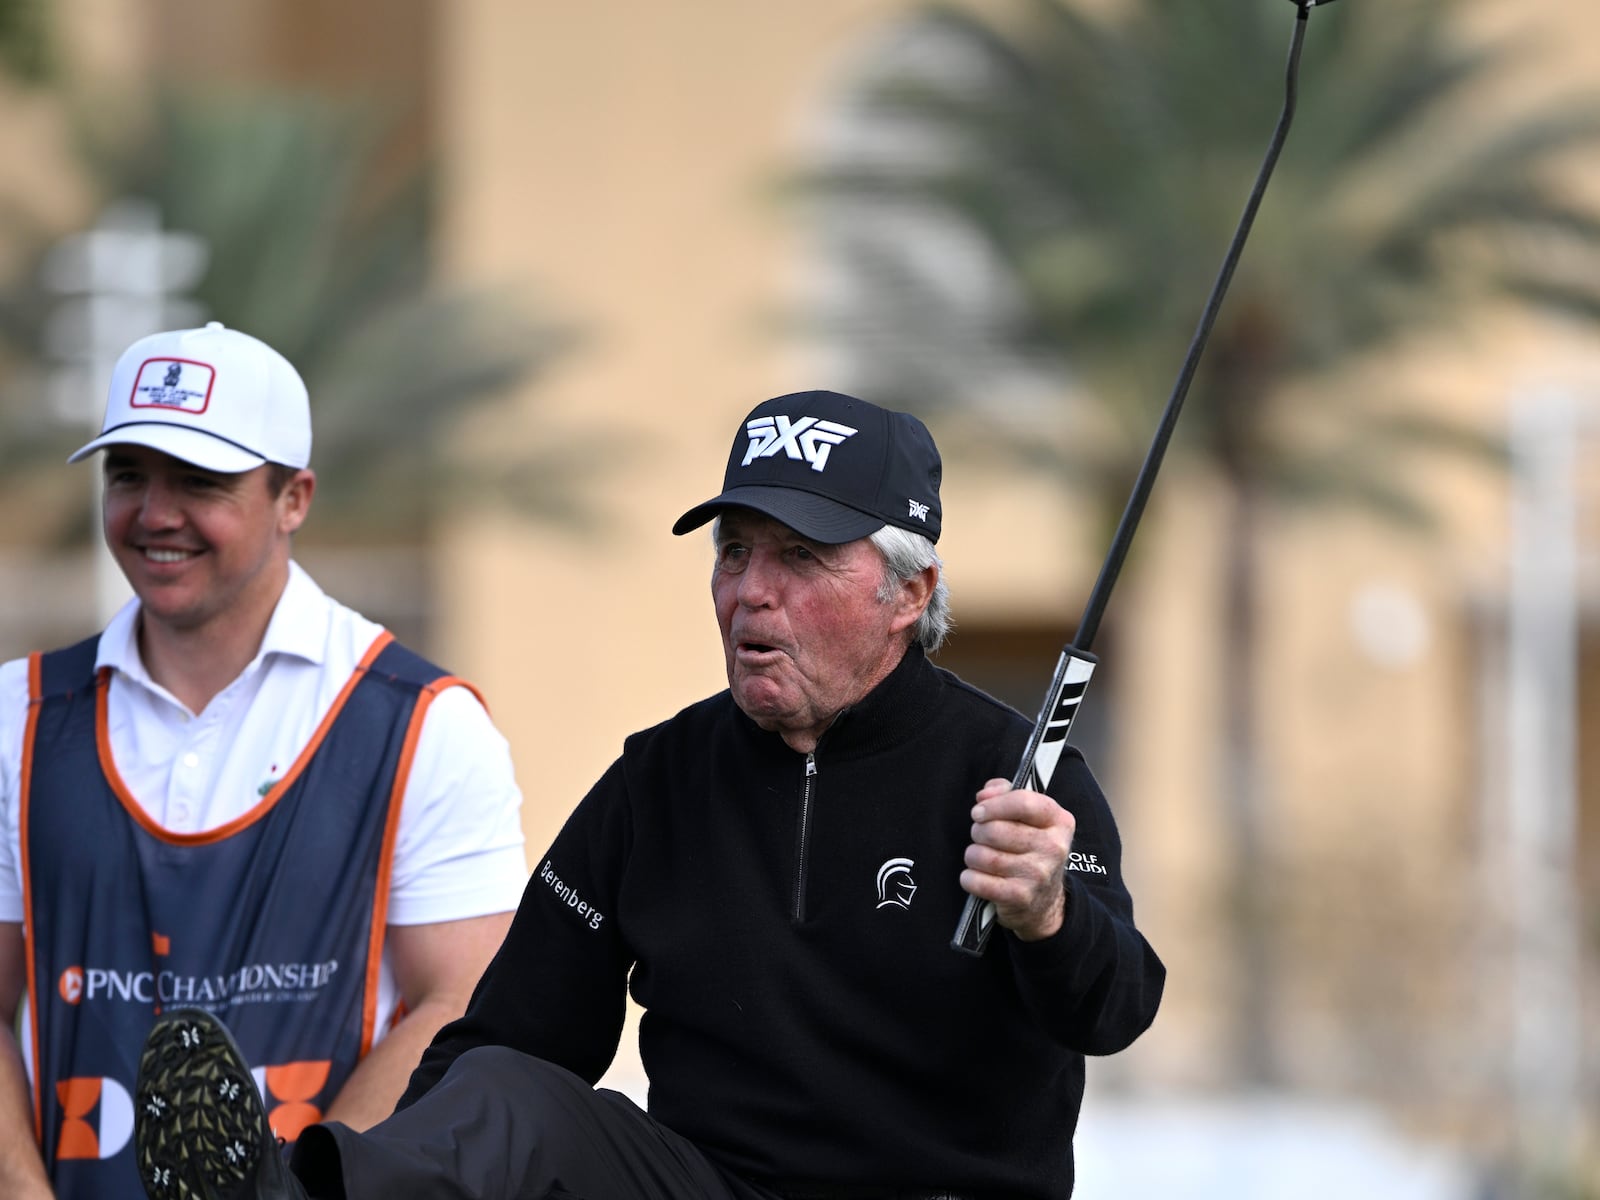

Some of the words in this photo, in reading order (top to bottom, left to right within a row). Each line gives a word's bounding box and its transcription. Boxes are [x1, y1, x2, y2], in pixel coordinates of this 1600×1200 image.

[741, 415, 859, 472] PXG
[908, 498, 930, 522] PXG
[1064, 862, 1107, 875] AUDI
[1068, 852, 1098, 864] OLF
[541, 860, 603, 930] Berenberg
[86, 969, 153, 1003] PNC
[157, 960, 338, 1003] CHAMIONSHIP
